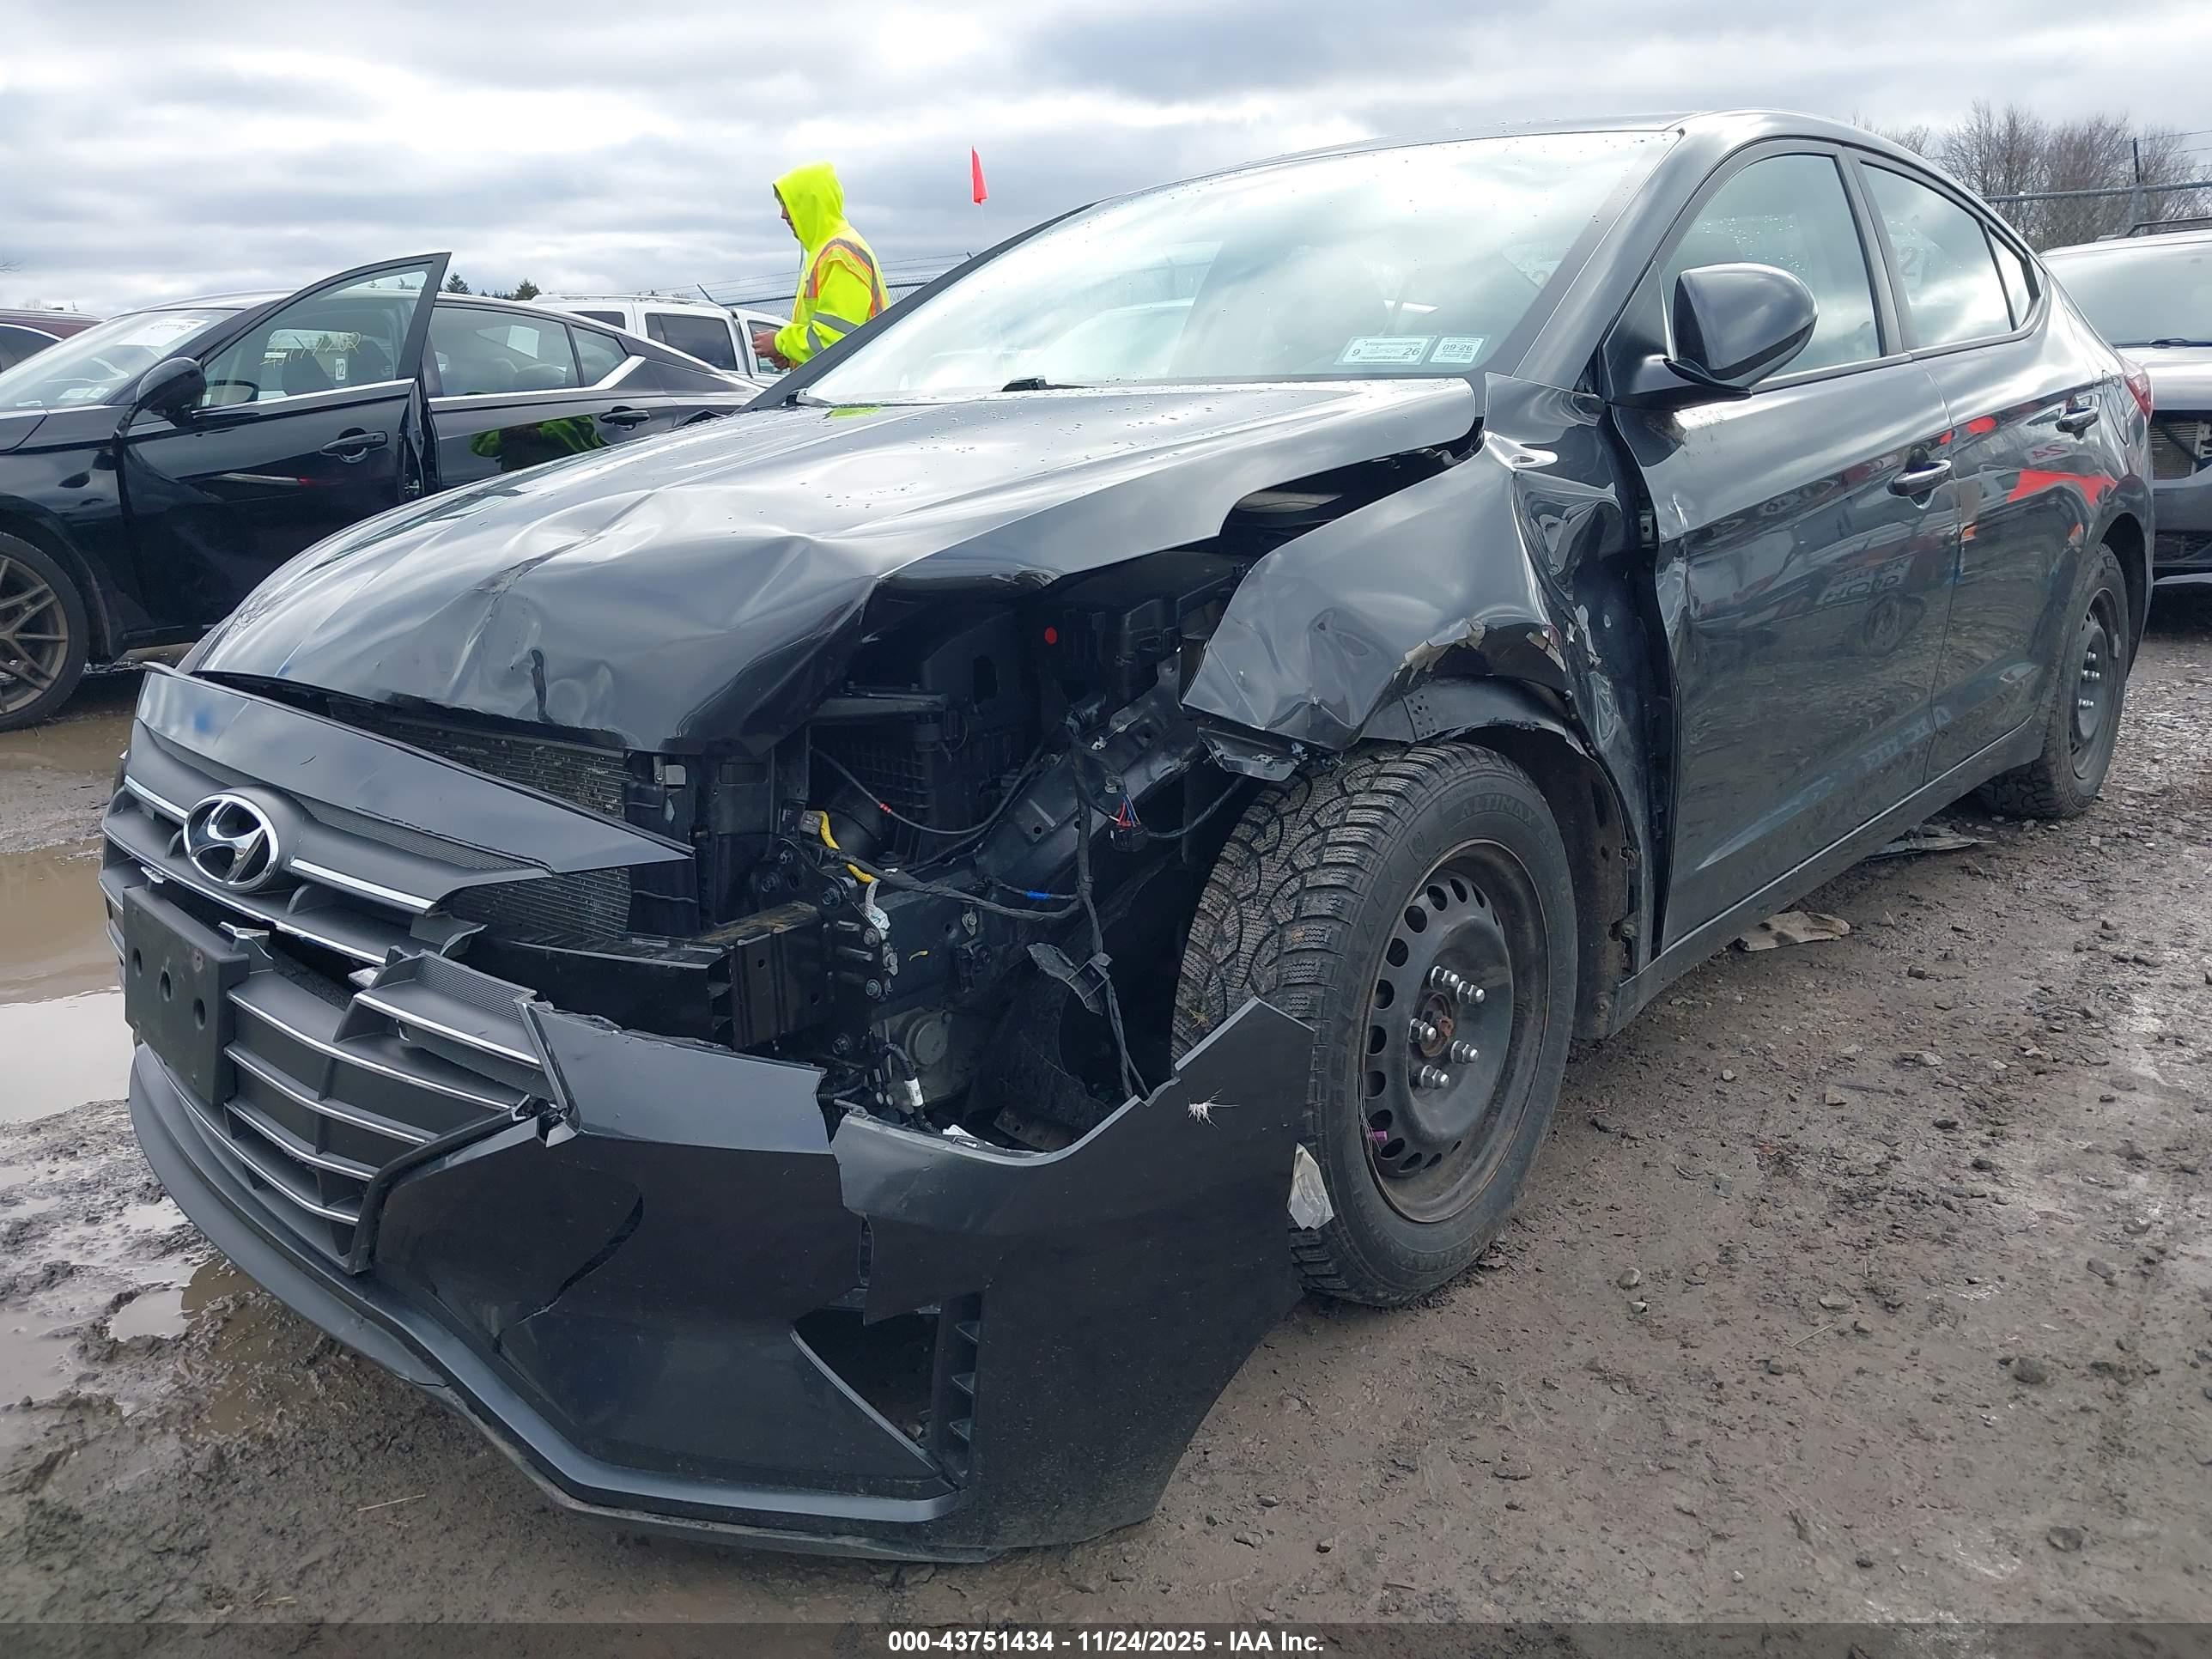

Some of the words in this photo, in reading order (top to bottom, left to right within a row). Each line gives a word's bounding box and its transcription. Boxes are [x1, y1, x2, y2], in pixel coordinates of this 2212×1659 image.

[1352, 349, 1361, 357] 9
[1401, 347, 1422, 356] 26
[337, 362, 344, 377] 12
[1462, 793, 1533, 827] ALTIMAX
